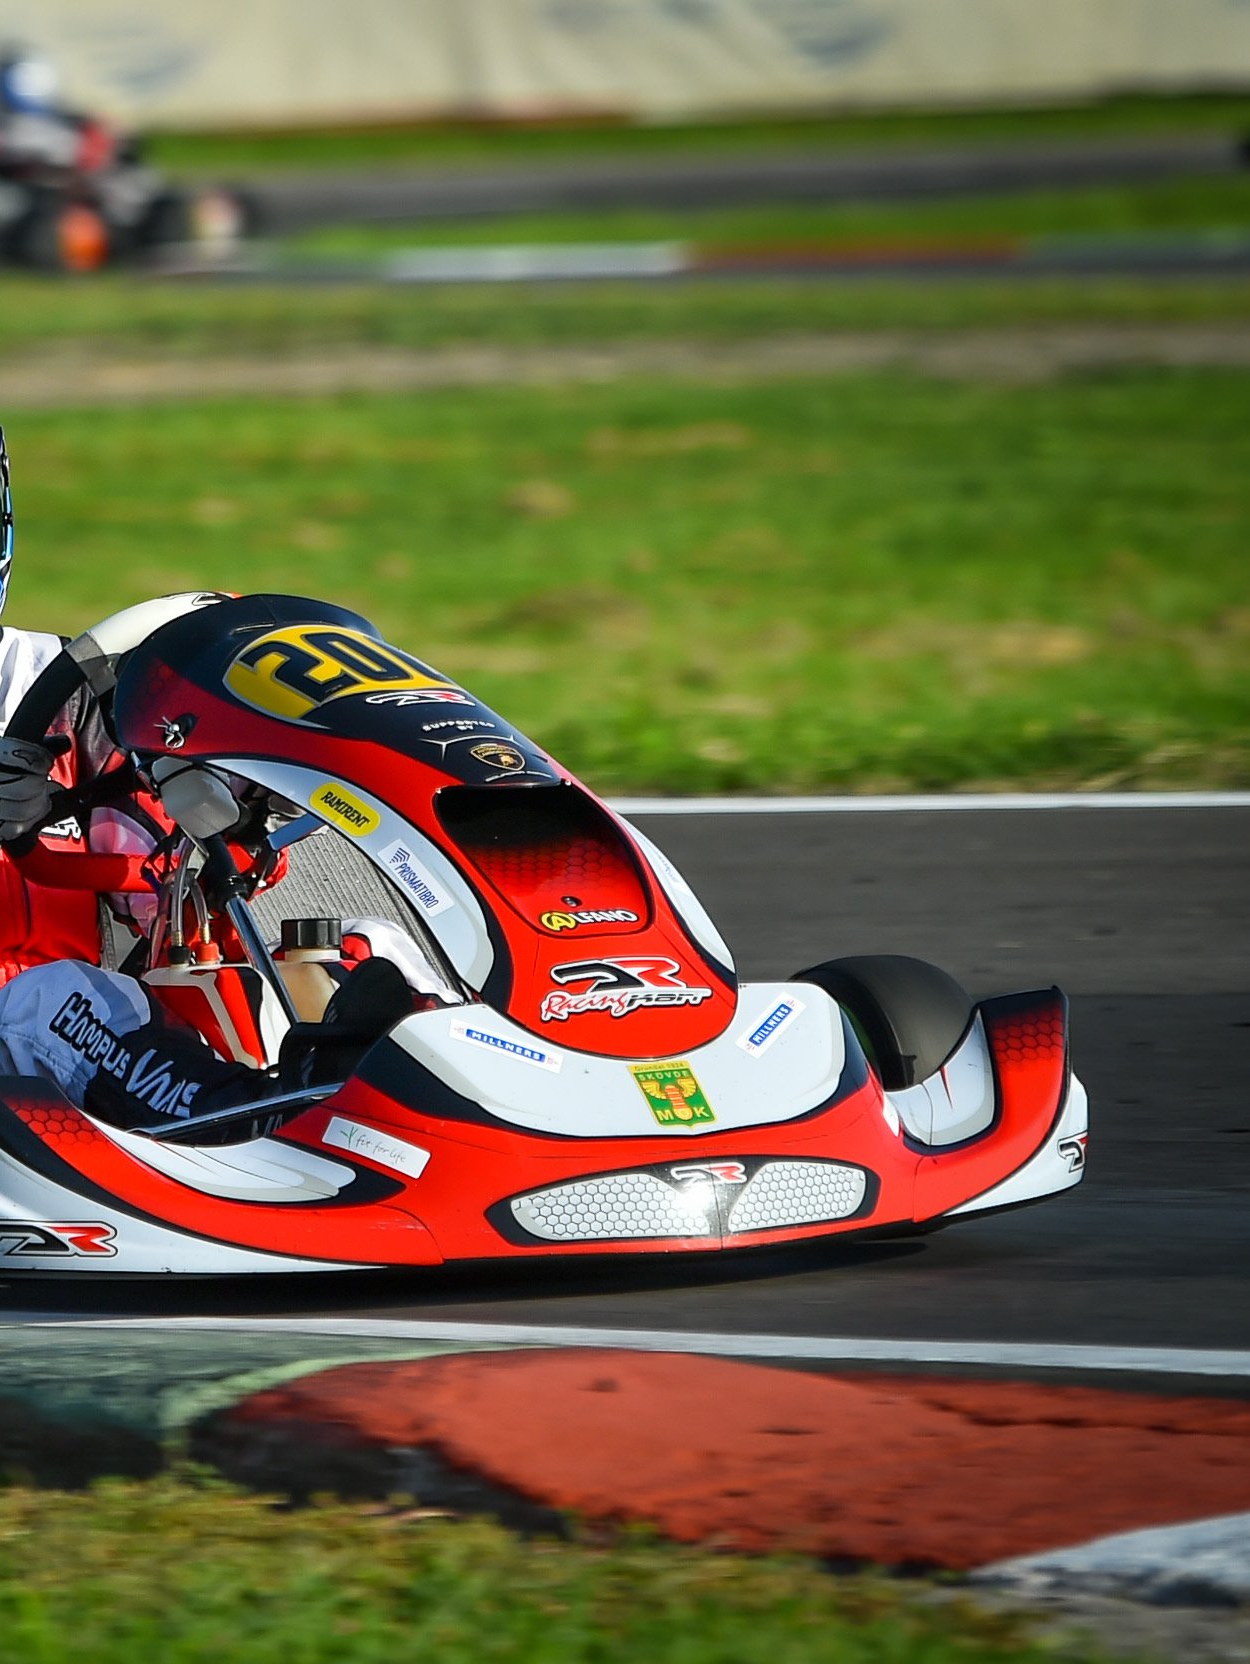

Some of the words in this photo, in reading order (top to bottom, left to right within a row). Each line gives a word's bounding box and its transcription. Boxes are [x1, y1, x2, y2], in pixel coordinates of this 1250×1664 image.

[320, 791, 371, 828] RAMIRENT
[394, 863, 439, 909] PRISMATIBRO
[541, 910, 638, 931] ALFANO
[752, 1006, 789, 1044] MILLNERS
[471, 1031, 541, 1061] MILLNERS
